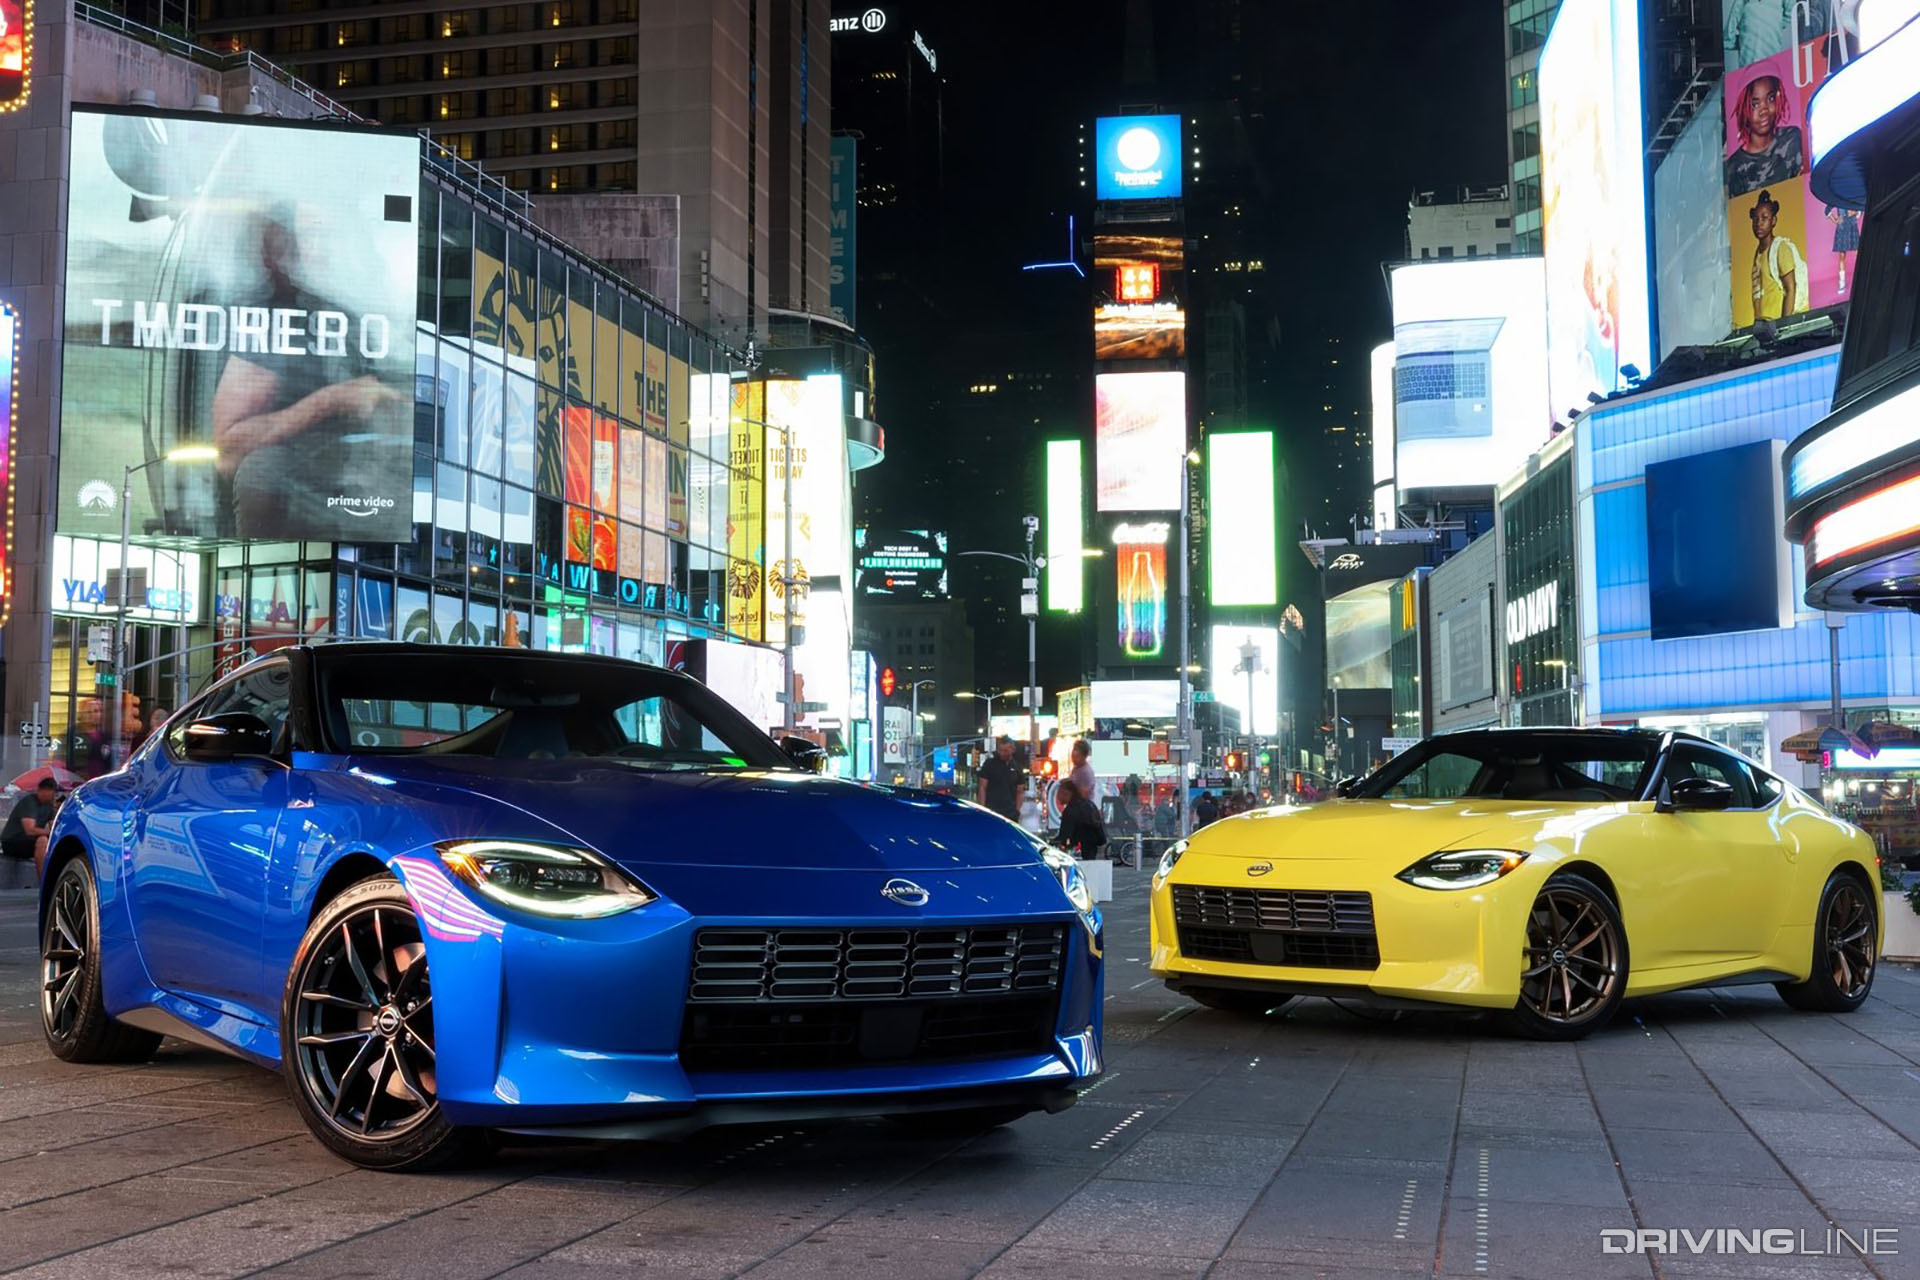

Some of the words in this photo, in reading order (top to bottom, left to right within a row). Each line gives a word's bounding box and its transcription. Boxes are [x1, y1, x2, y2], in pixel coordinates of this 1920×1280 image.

[327, 495, 362, 508] prime
[362, 495, 394, 508] video
[1506, 597, 1526, 645] OLD
[1527, 580, 1558, 637] NAVY
